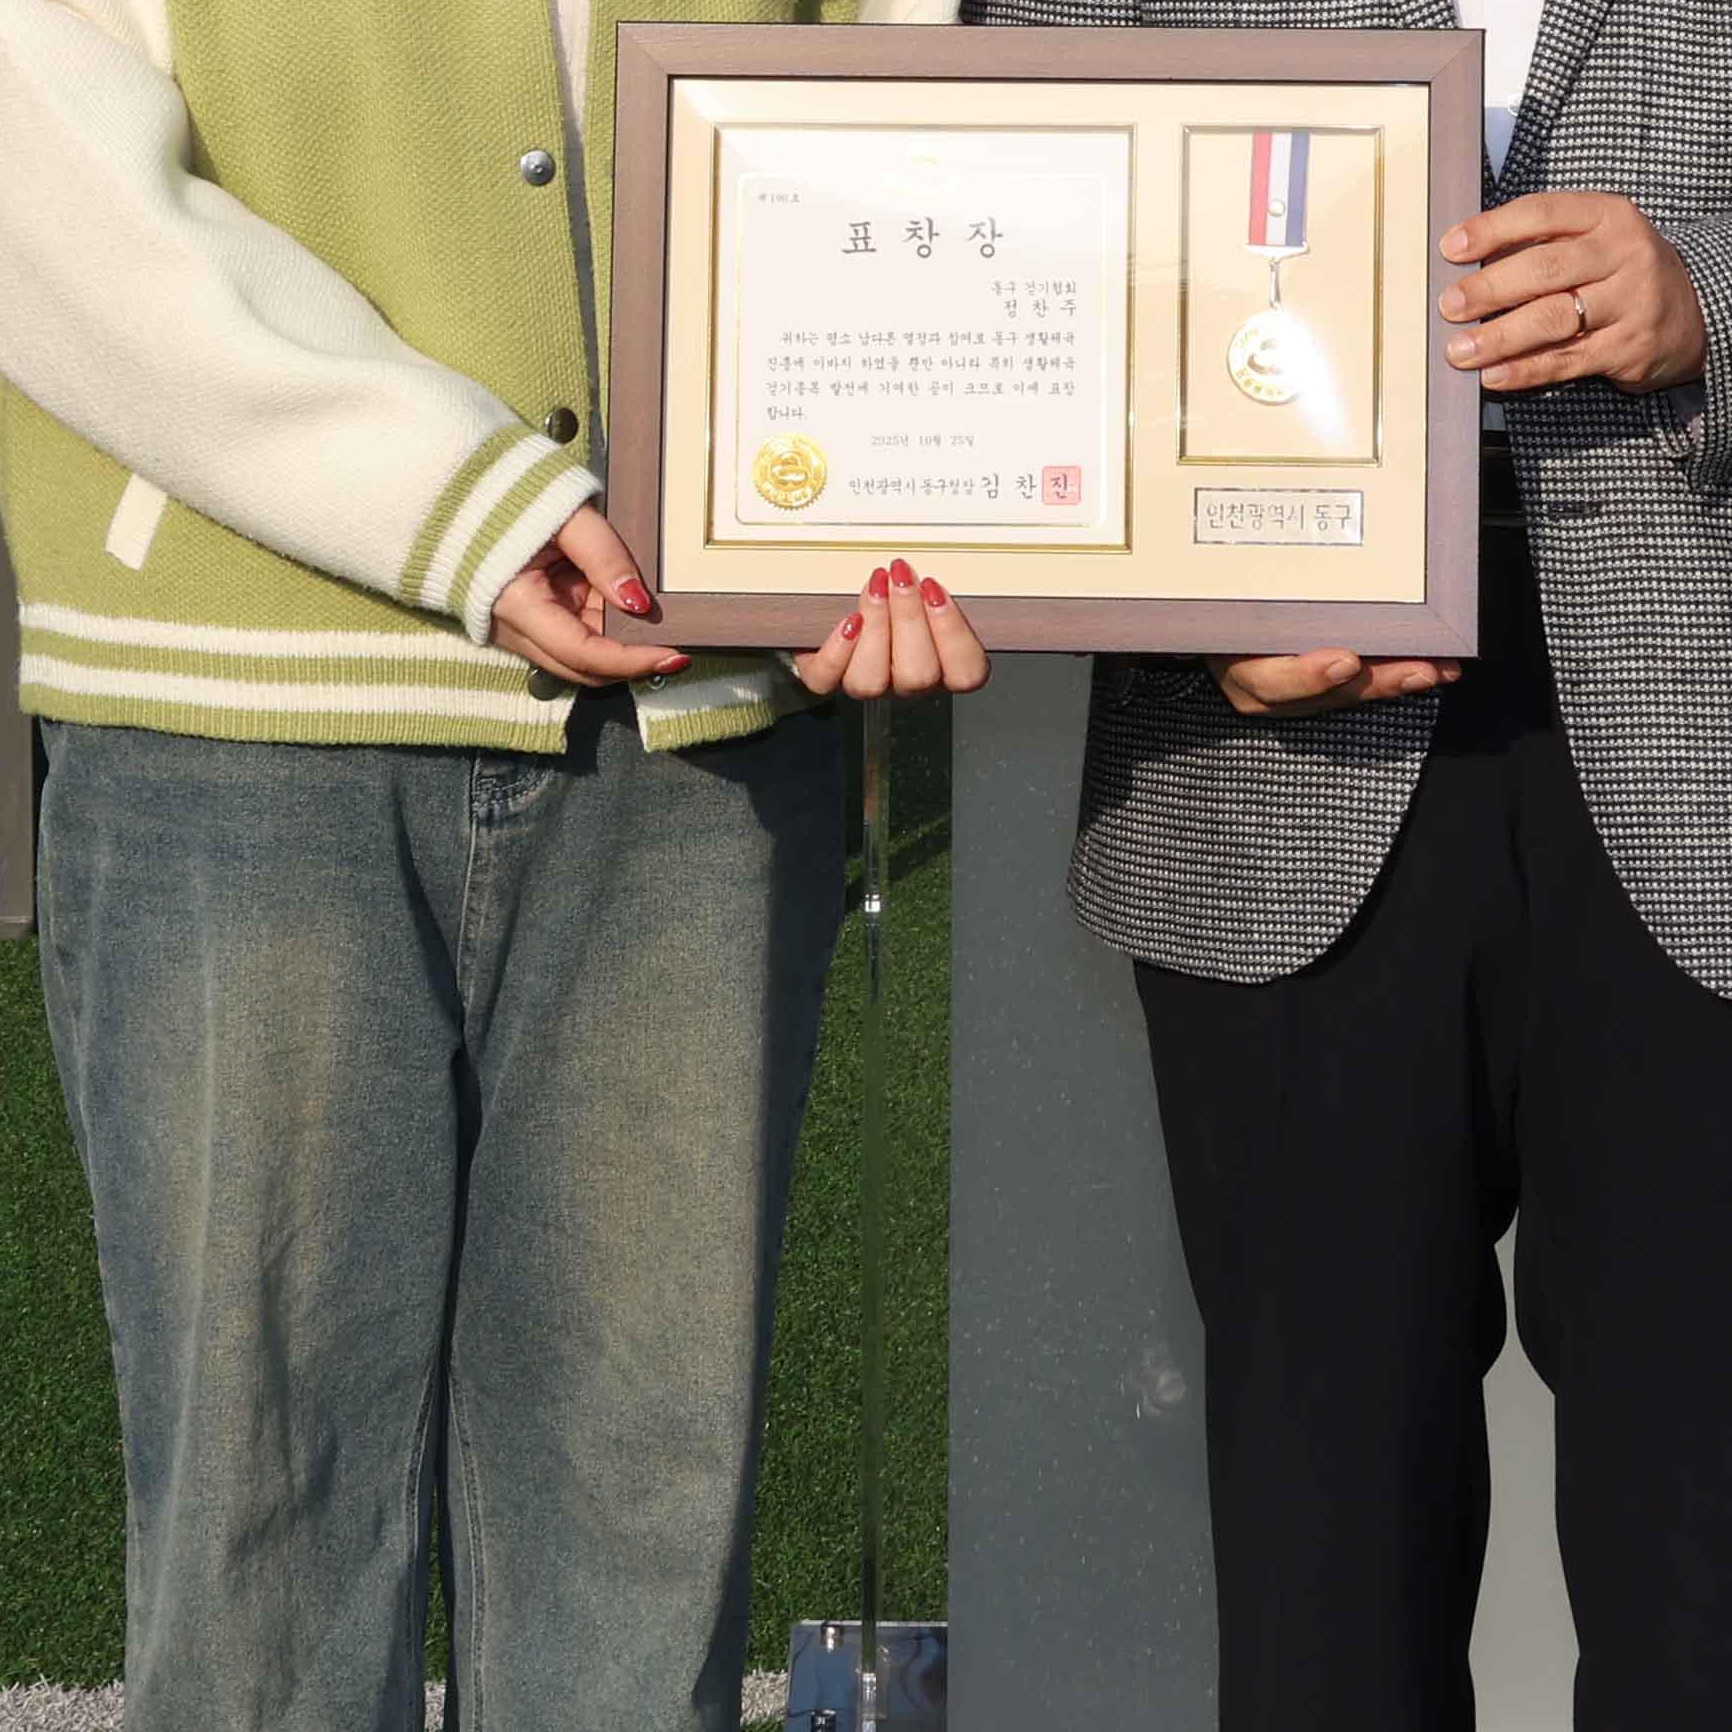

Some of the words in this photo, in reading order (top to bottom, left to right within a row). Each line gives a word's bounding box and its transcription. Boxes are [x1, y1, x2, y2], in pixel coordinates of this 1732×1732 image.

[991, 280, 1017, 296] 동구
[779, 331, 819, 347] 귀하는
[991, 331, 1019, 347] 동구
[811, 355, 851, 373] 이바지
[939, 355, 980, 372] 아니라
[963, 381, 1004, 396] 크므로
[1011, 379, 1039, 397] 이에
[870, 433, 908, 448] 2025년
[918, 433, 941, 448] 10월
[949, 434, 975, 448] 25일
[848, 476, 916, 496] 인천광역시
[1206, 501, 1305, 532] 인천광역시
[1314, 502, 1353, 532] 동구
